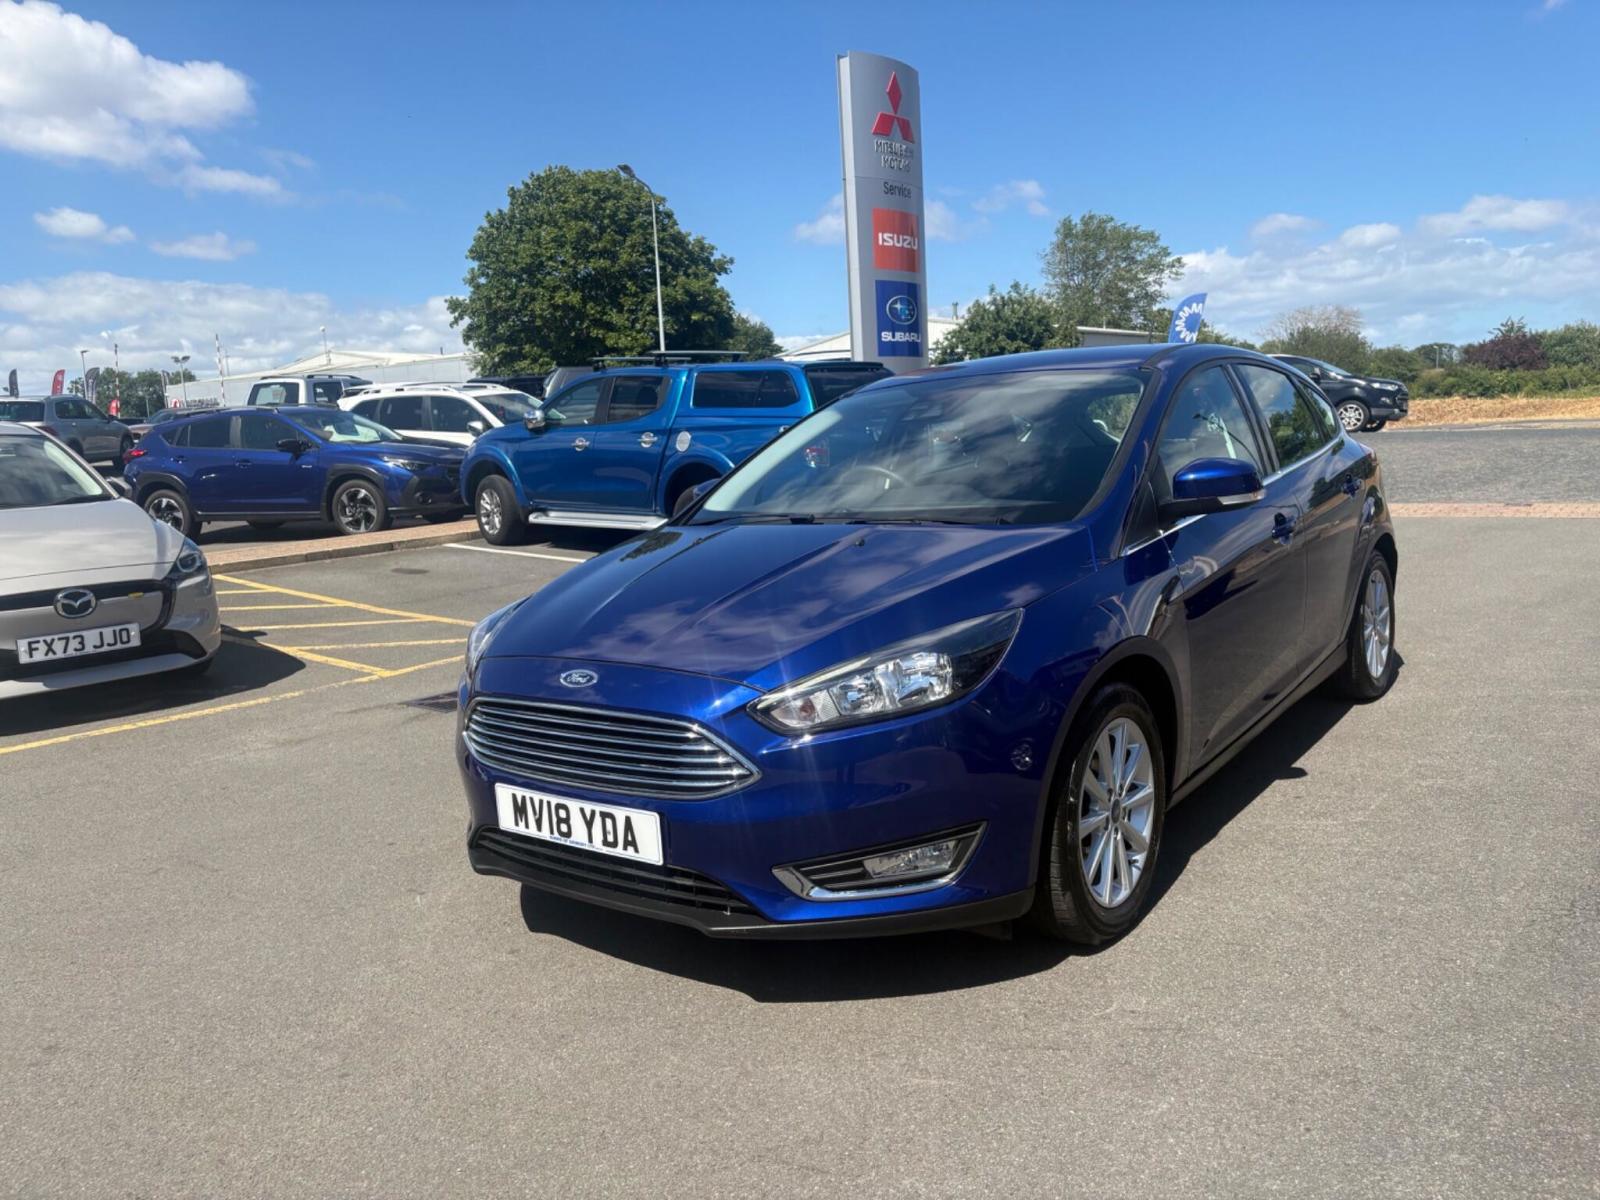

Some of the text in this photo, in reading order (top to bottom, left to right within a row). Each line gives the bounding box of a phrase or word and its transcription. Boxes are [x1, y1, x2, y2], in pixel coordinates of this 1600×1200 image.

[873, 139, 914, 159] MITSUB
[883, 181, 912, 199] Service
[878, 232, 919, 250] ISUZU
[881, 331, 921, 343] SUBARU
[27, 627, 131, 659] FX73 JJO
[566, 672, 591, 684] Ford
[511, 793, 640, 854] MV18 YDA
